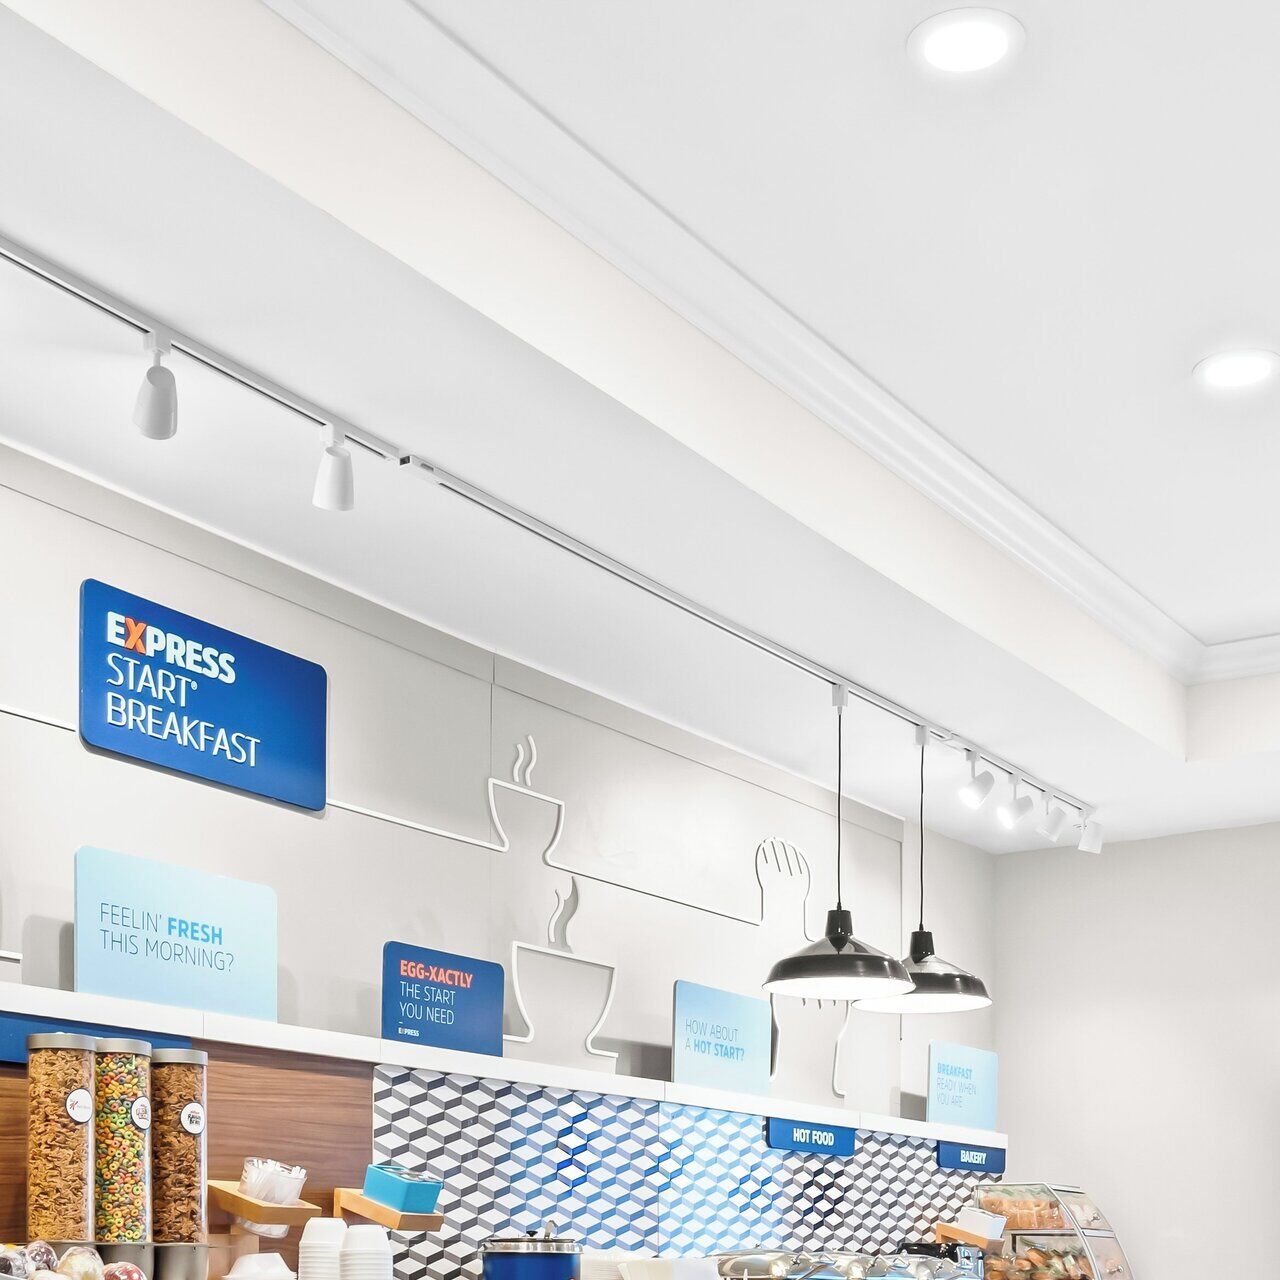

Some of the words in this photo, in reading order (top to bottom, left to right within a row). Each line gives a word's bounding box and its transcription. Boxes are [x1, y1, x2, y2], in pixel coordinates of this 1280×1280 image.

[106, 611, 236, 684] EXPRESS
[106, 692, 260, 767] BREAKFAST
[100, 902, 162, 932] FEELIN'
[167, 917, 223, 945] FRESH
[100, 929, 139, 955] THIS
[145, 938, 234, 972] MORNING?
[400, 960, 473, 988] EGG-XACTLY
[400, 981, 420, 999] THE
[423, 986, 456, 1006] START
[400, 1001, 423, 1020] YOU
[426, 1006, 455, 1025] NEED
[685, 1019, 708, 1036] HOW
[710, 1024, 738, 1042] ABOUT
[685, 1037, 691, 1051] A
[693, 1039, 712, 1055] HOT
[714, 1043, 745, 1061] START?
[793, 1128, 811, 1143] HOT
[812, 1130, 835, 1146] FOOD
[960, 1150, 987, 1165] BAKERY
